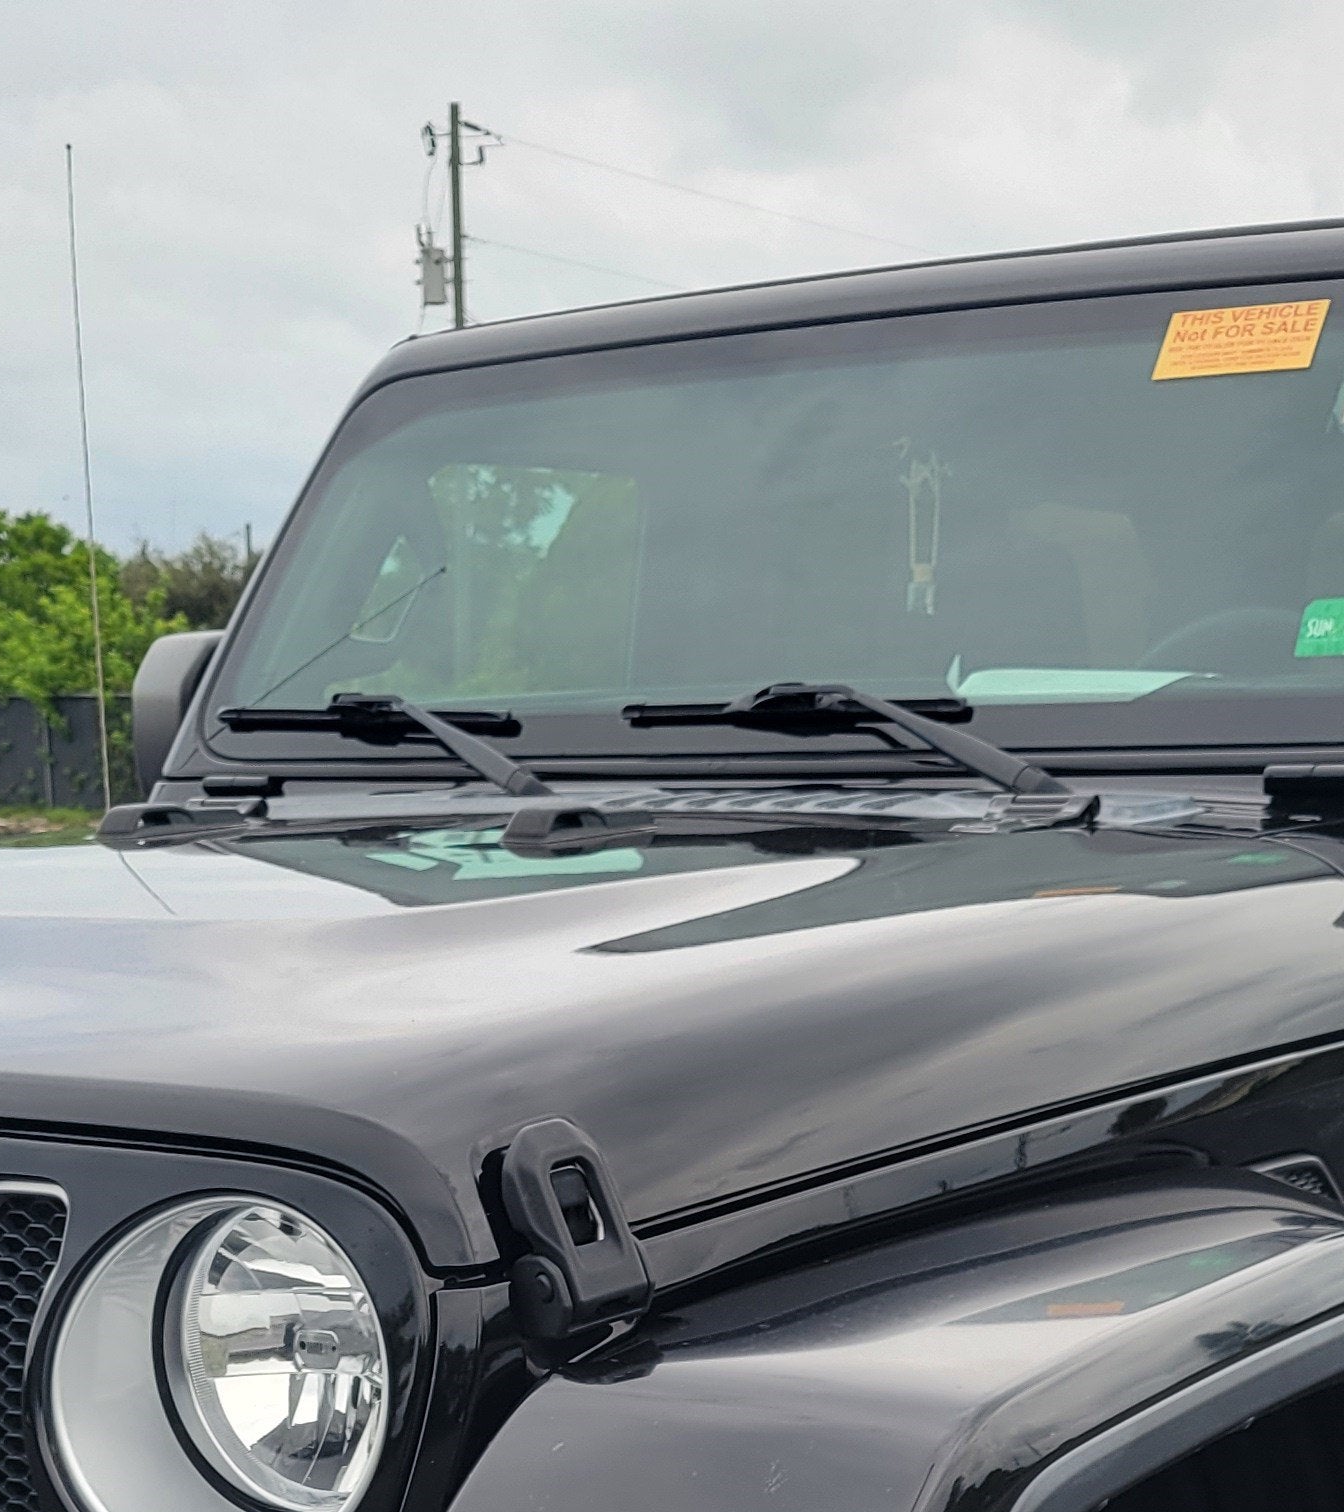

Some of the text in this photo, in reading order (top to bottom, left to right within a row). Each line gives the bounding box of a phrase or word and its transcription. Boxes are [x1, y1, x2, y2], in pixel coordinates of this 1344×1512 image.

[1181, 302, 1323, 327] THIS VEHICLE
[1172, 317, 1320, 344] Not FOR SALE
